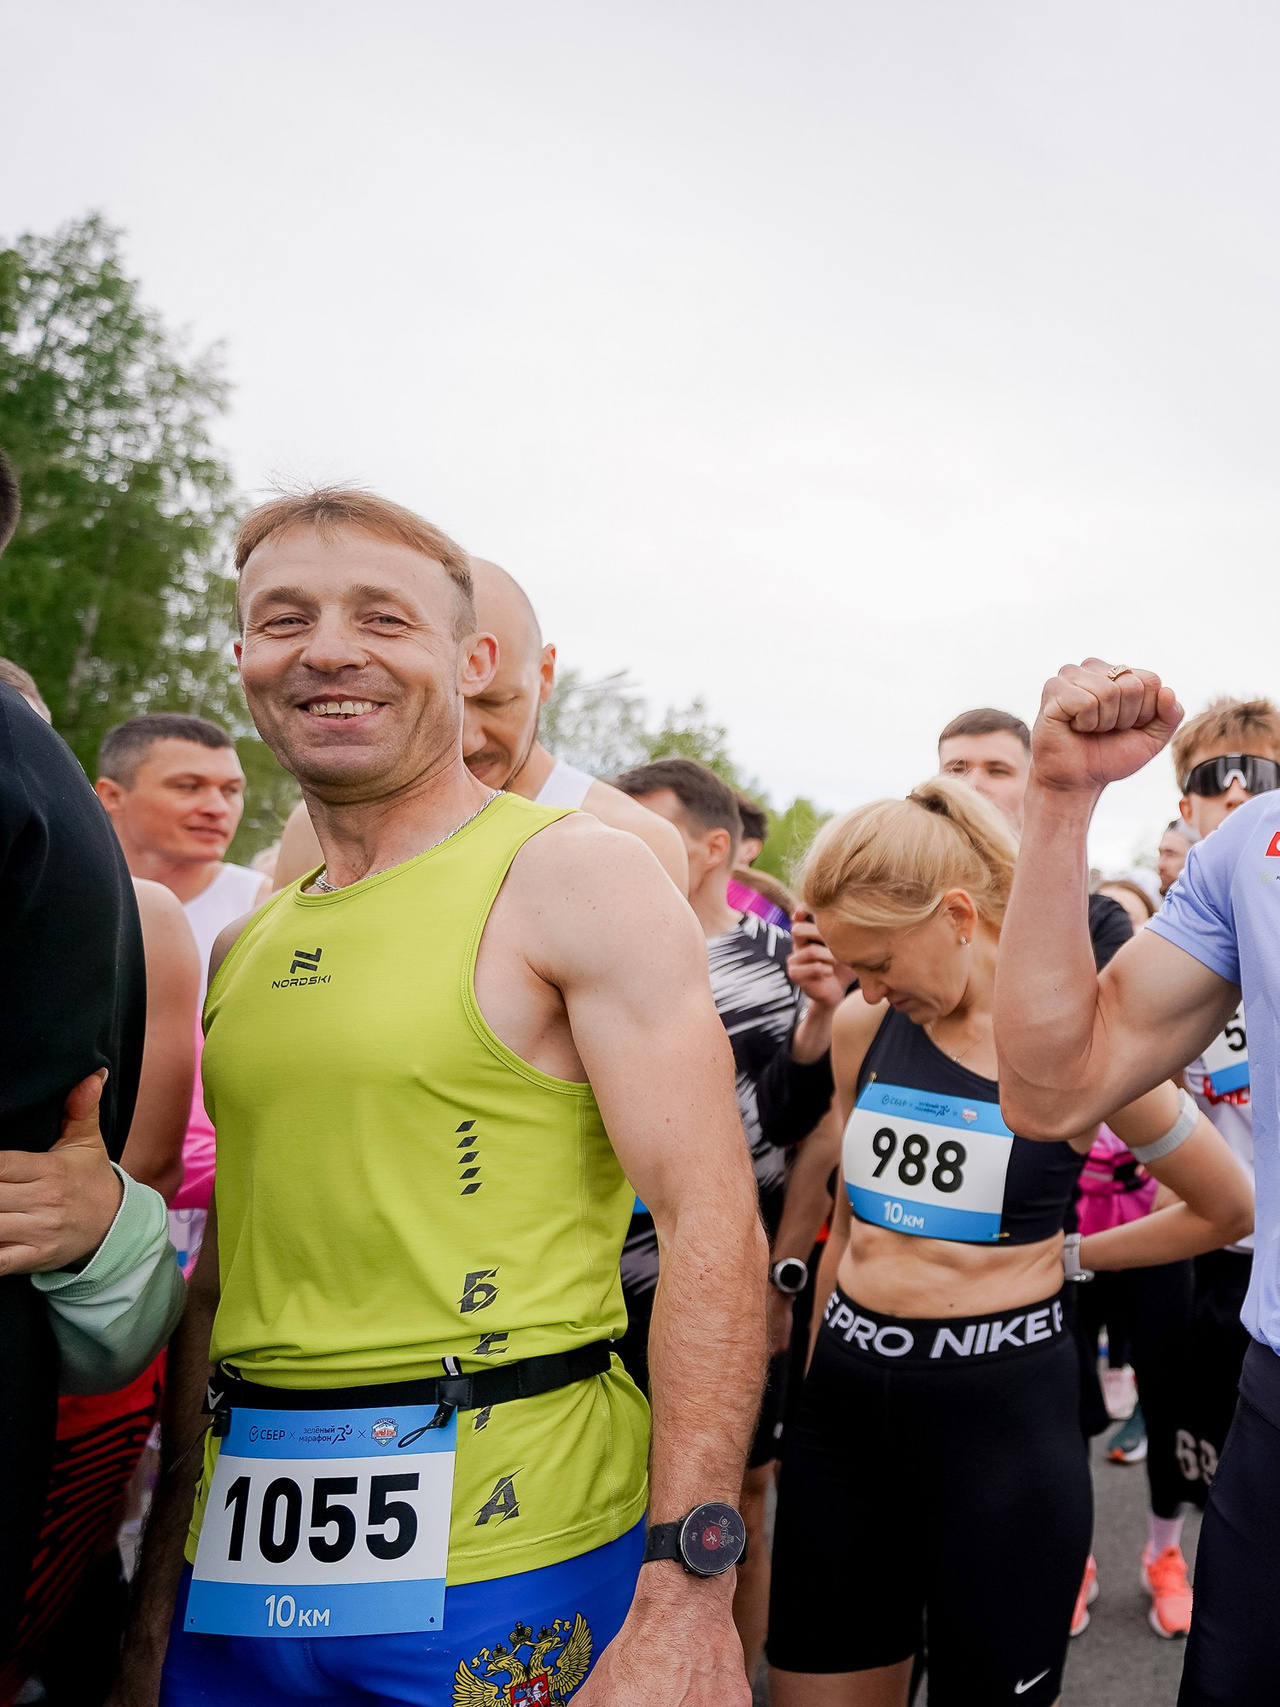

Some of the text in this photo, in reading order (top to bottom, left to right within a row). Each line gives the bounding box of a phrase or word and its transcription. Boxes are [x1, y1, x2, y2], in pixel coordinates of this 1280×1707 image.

[271, 975, 332, 989] NORDSKI
[871, 1127, 967, 1193] 988
[828, 1303, 914, 1357] PRO
[930, 1308, 1052, 1359] NIKE
[260, 1429, 286, 1441] СБЕР
[299, 1435, 332, 1444] марафон
[224, 1472, 420, 1564] 1055
[264, 1594, 296, 1628] 10
